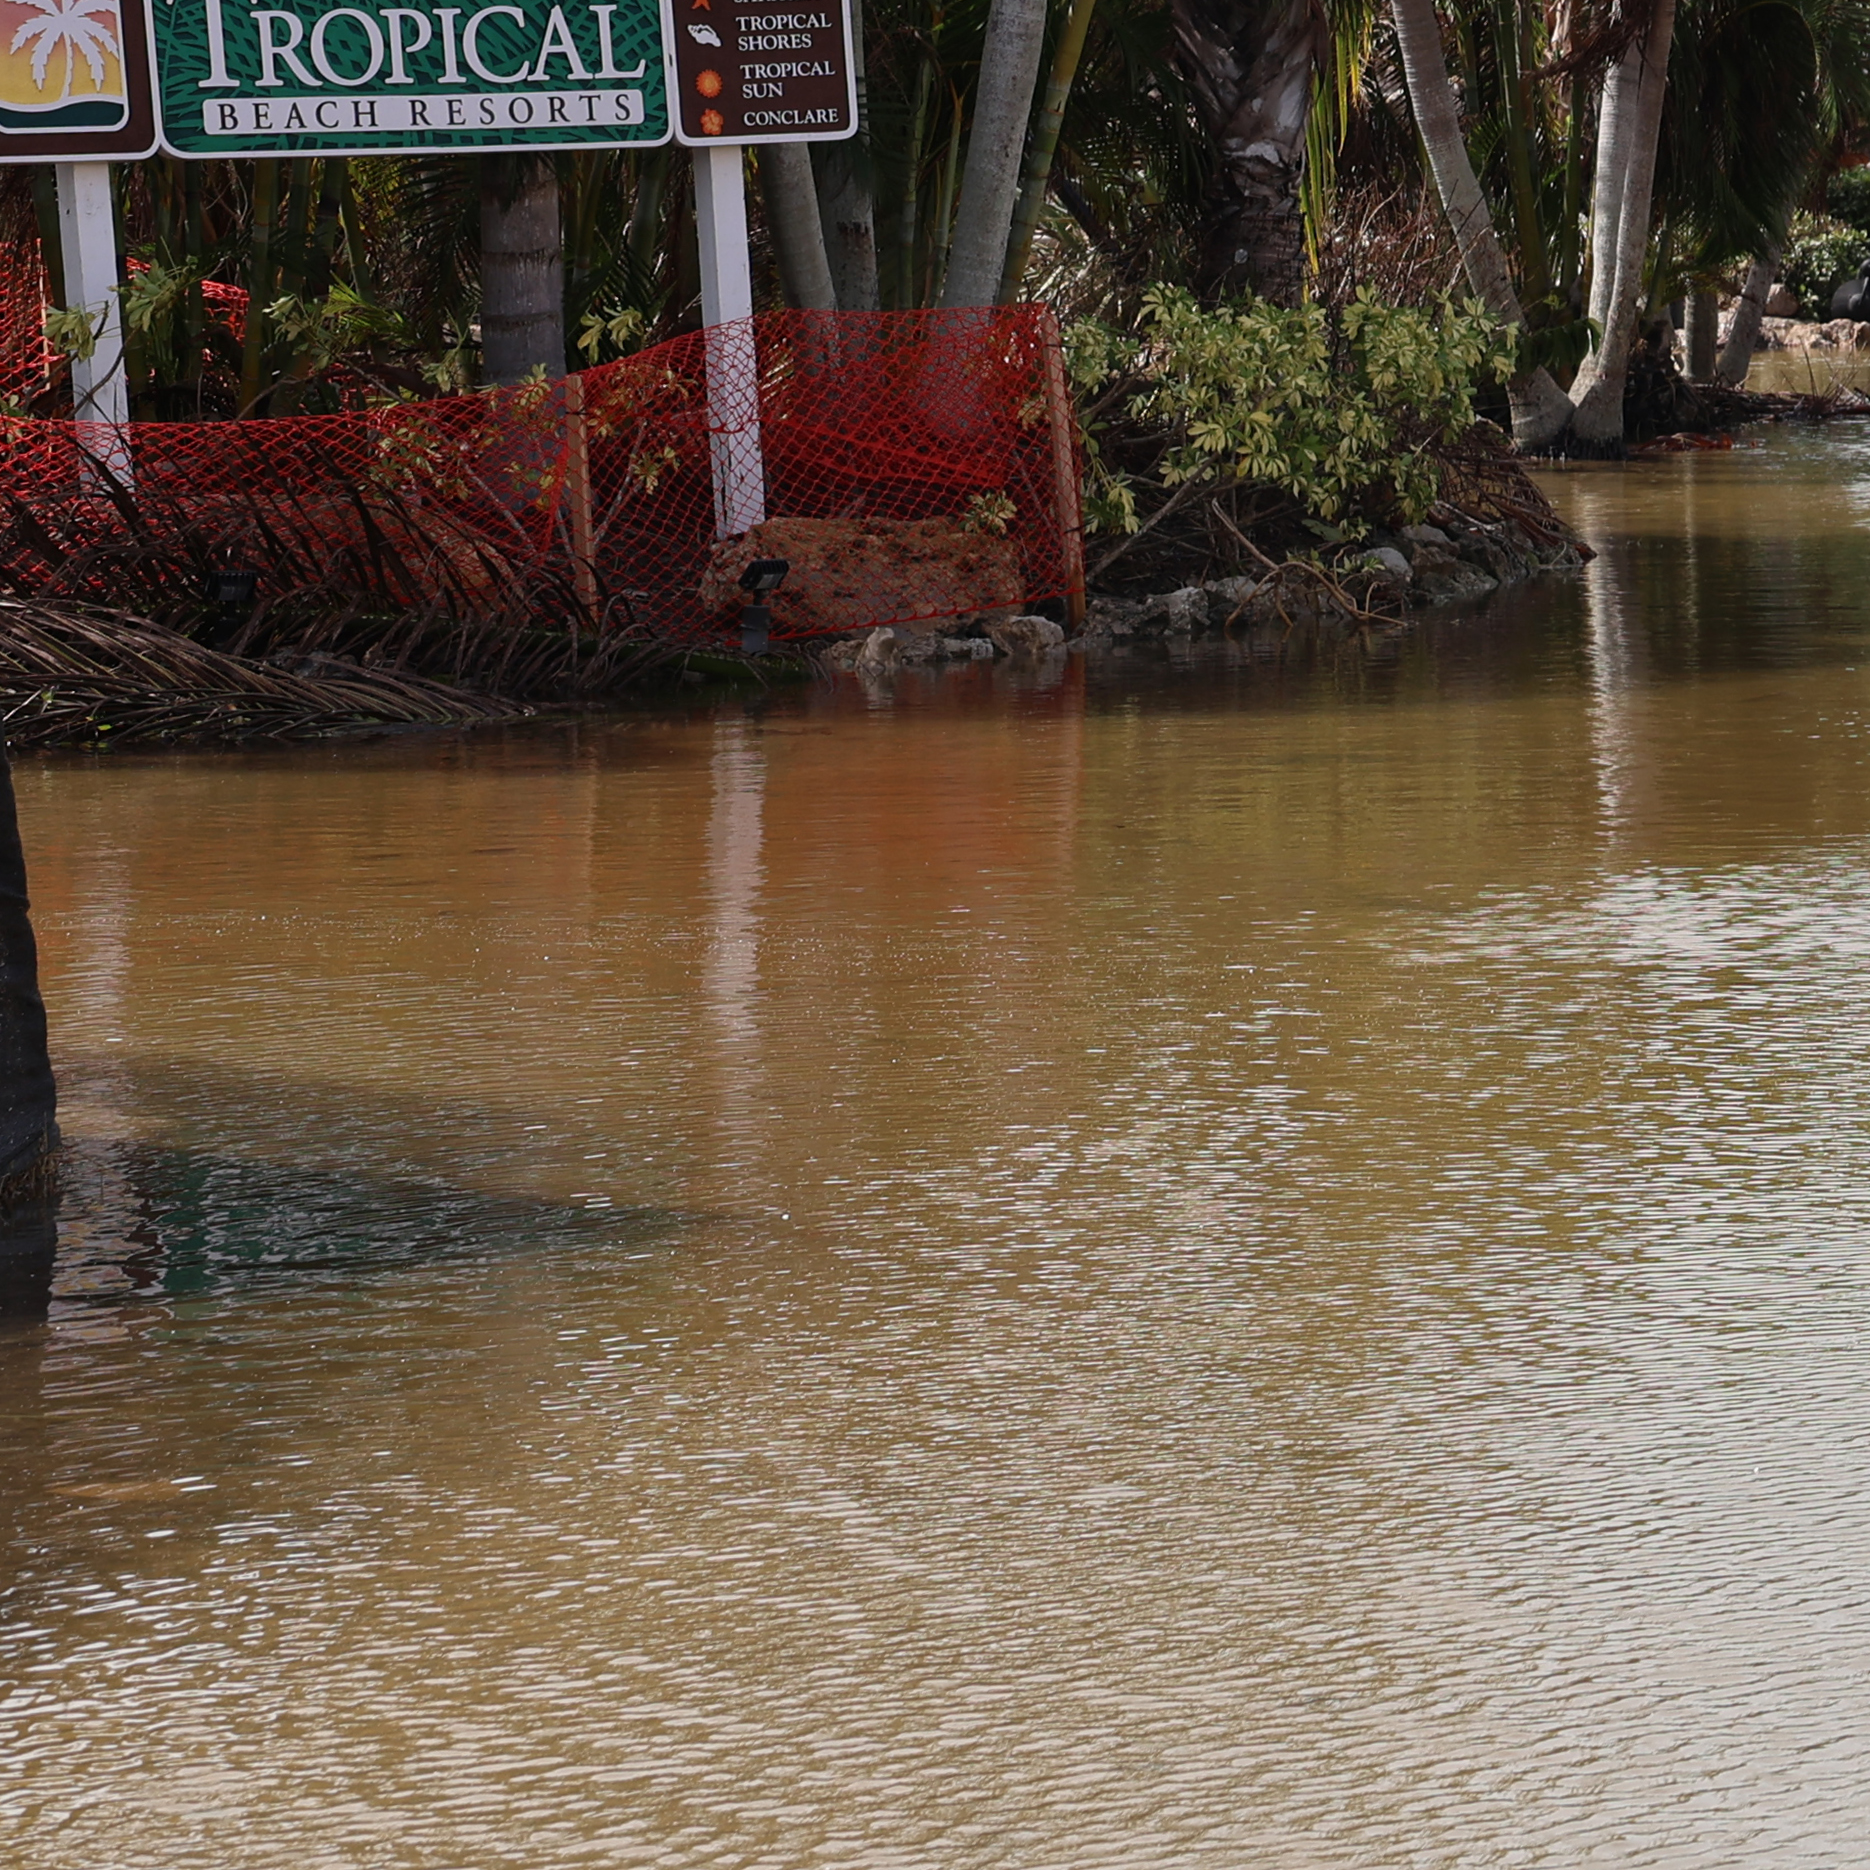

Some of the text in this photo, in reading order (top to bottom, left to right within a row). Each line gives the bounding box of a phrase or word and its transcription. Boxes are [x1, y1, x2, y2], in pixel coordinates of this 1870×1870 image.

[735, 13, 832, 31] TROPICAL
[737, 33, 812, 51] SHORES
[740, 61, 836, 79] TROPICAL
[742, 82, 783, 99] SUN
[218, 93, 632, 131] BEACH RESORTS
[743, 108, 839, 126] CONCLARE
